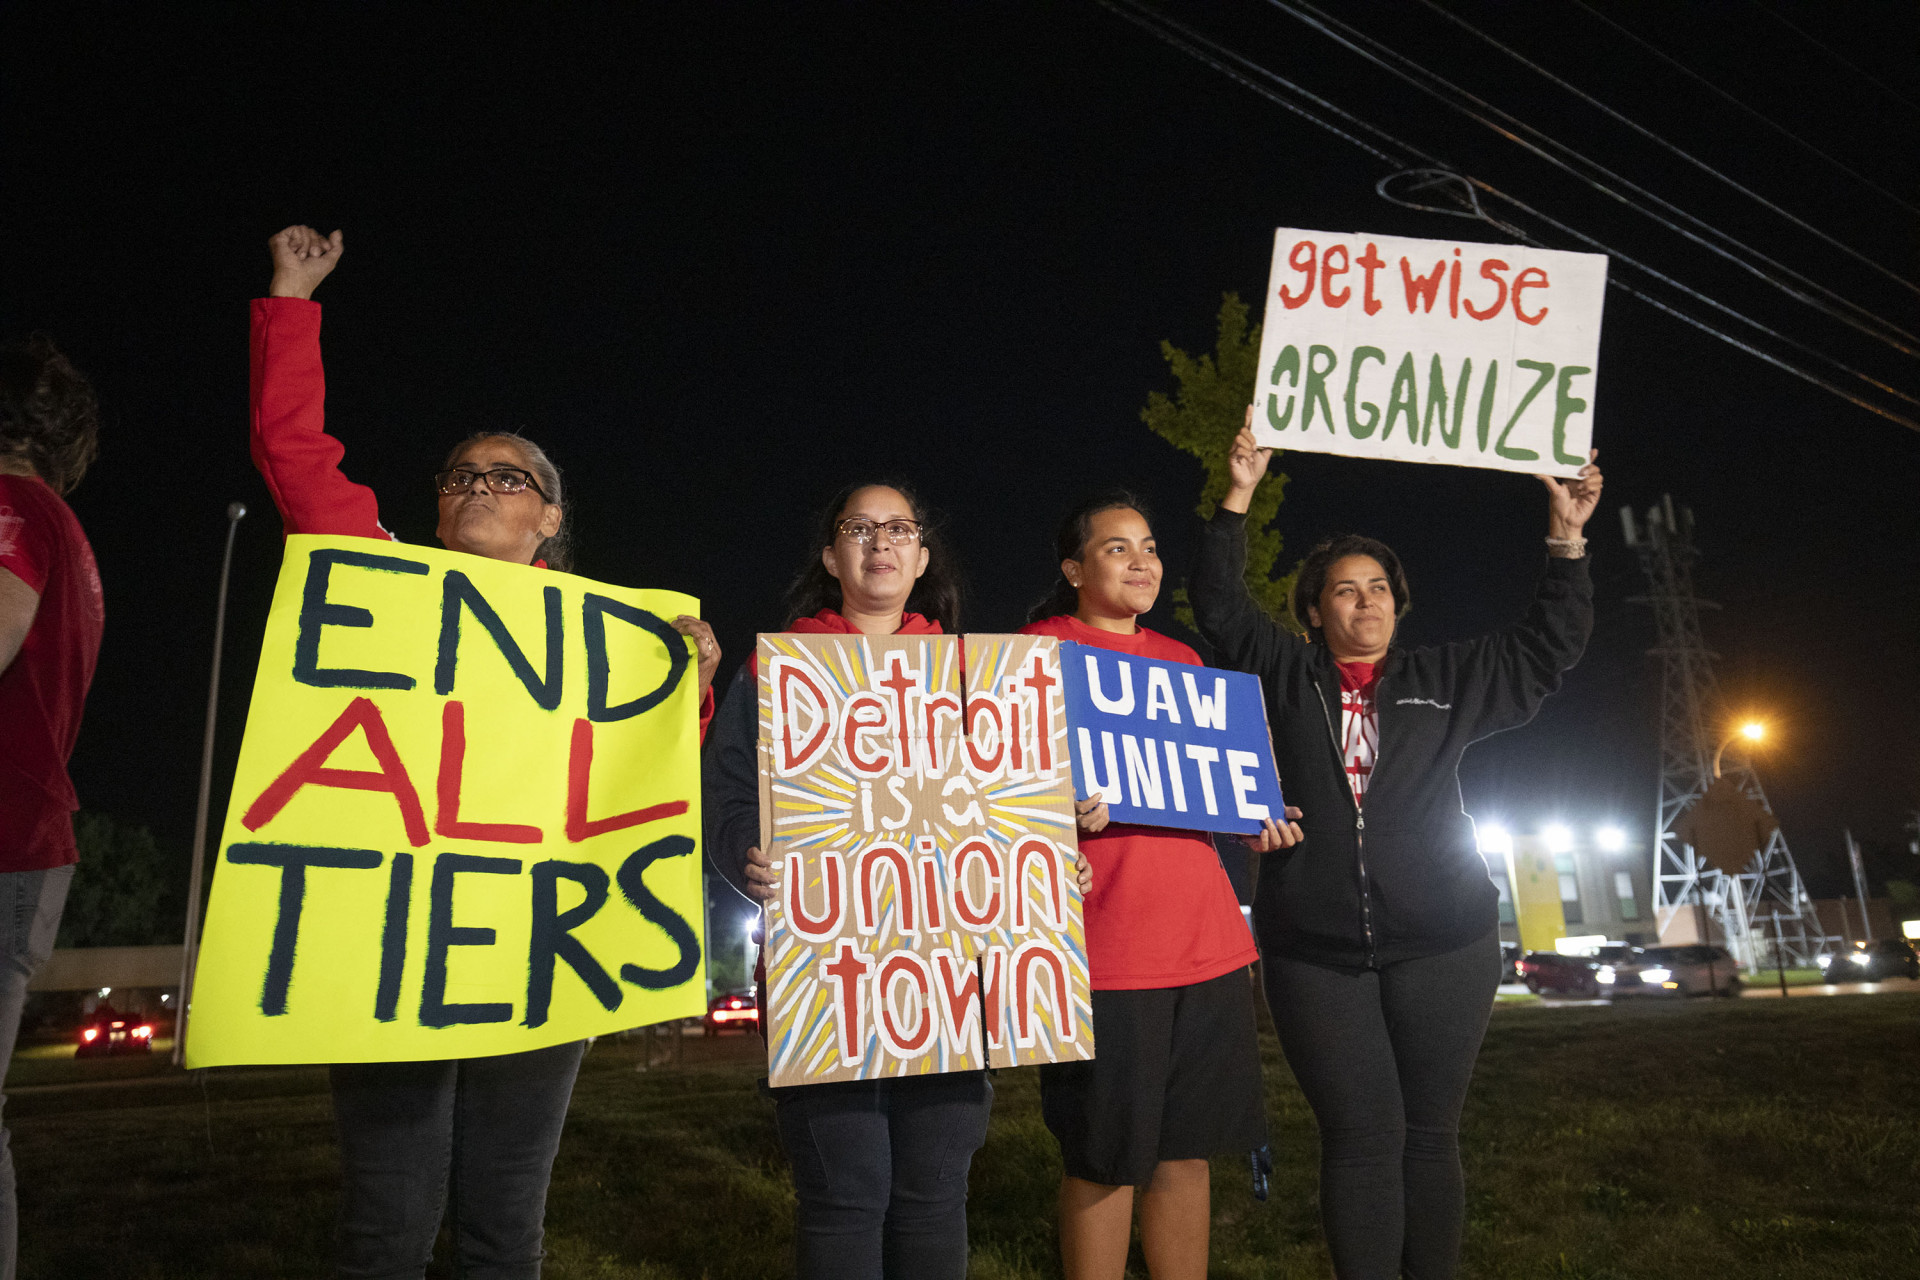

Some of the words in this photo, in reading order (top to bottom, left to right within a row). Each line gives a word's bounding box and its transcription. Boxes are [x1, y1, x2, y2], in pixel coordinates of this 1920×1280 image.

[1279, 240, 1386, 316] get
[1400, 247, 1549, 325] wise
[1267, 344, 1592, 466] ORGANIZE
[292, 549, 690, 722] END
[1085, 655, 1227, 730] UAW
[241, 697, 690, 847] ALL
[770, 650, 1061, 778] Detroit
[1077, 727, 1270, 821] UNITE
[860, 776, 913, 832] is
[942, 776, 984, 828] a
[226, 835, 701, 1029] TIERS
[820, 938, 1076, 1066] town
